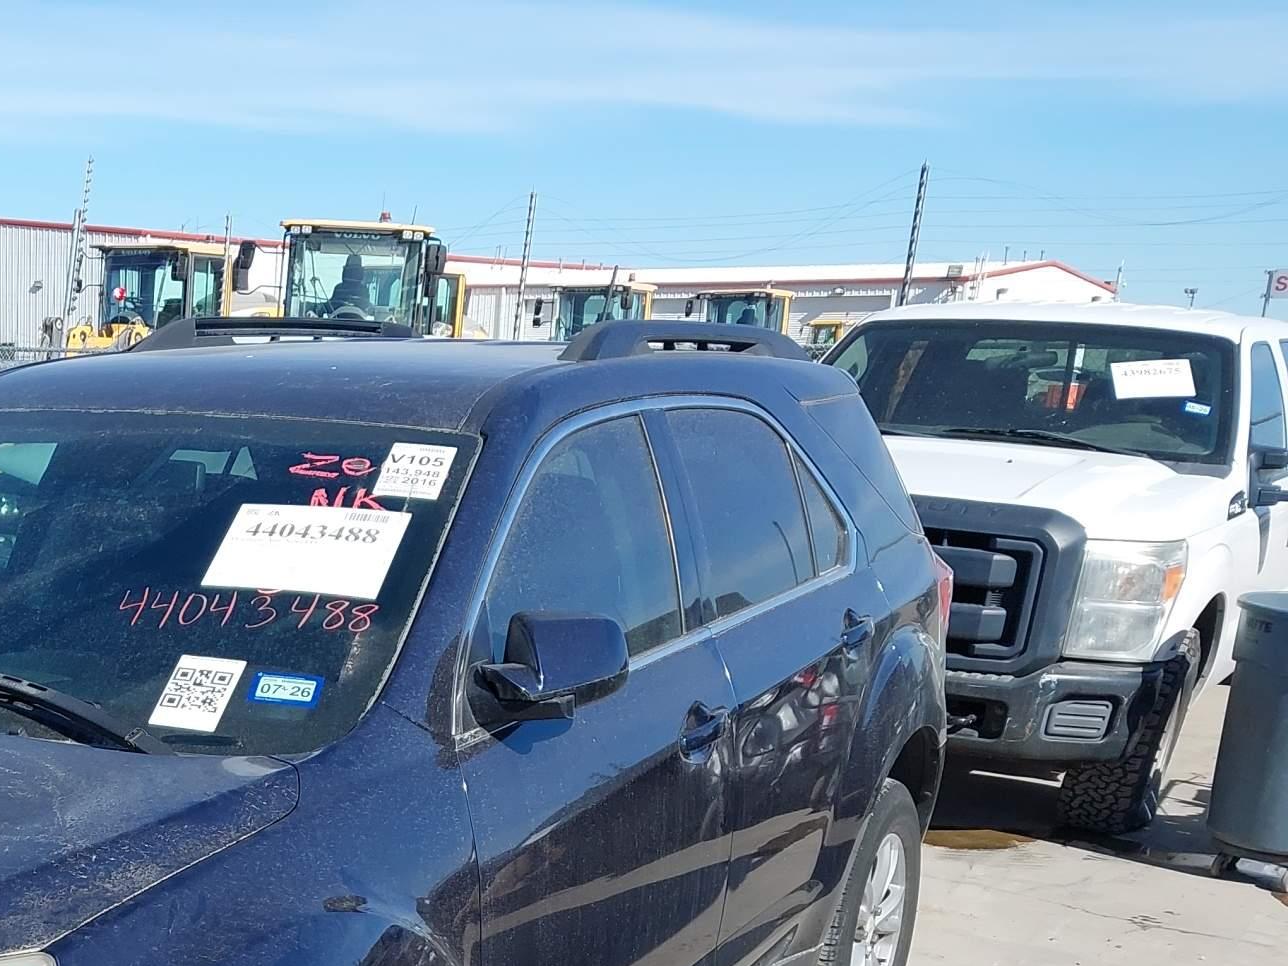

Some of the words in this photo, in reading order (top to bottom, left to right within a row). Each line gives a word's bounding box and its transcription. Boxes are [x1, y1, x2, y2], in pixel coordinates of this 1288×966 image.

[391, 453, 446, 467] V105
[401, 477, 437, 487] 2016
[245, 521, 380, 544] 44043488
